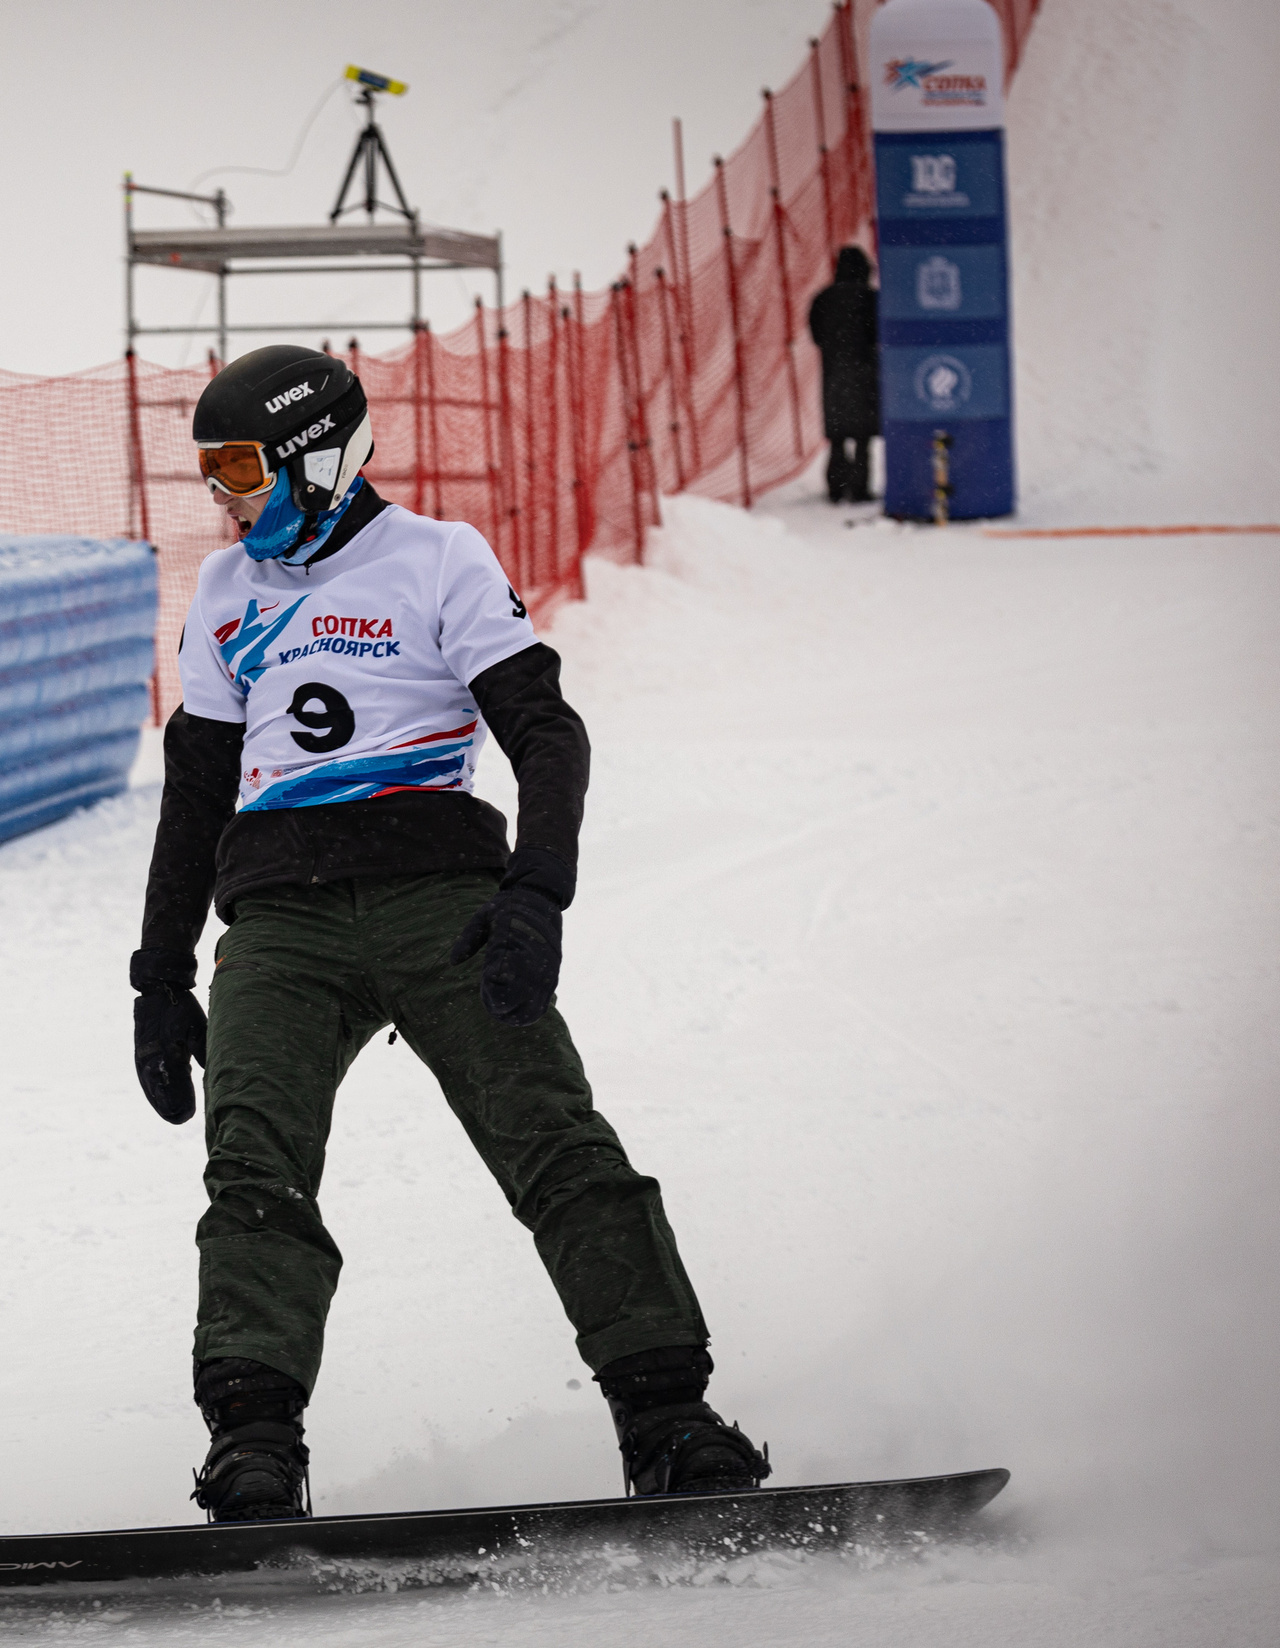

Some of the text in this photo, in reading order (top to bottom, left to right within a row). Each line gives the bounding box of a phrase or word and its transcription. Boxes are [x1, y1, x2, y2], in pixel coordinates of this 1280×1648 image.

[265, 381, 315, 413] uvex
[275, 413, 336, 459] uvex
[312, 615, 393, 638] СОПКА
[279, 637, 400, 665] КРАСНОЯРСК
[286, 682, 356, 754] 9
